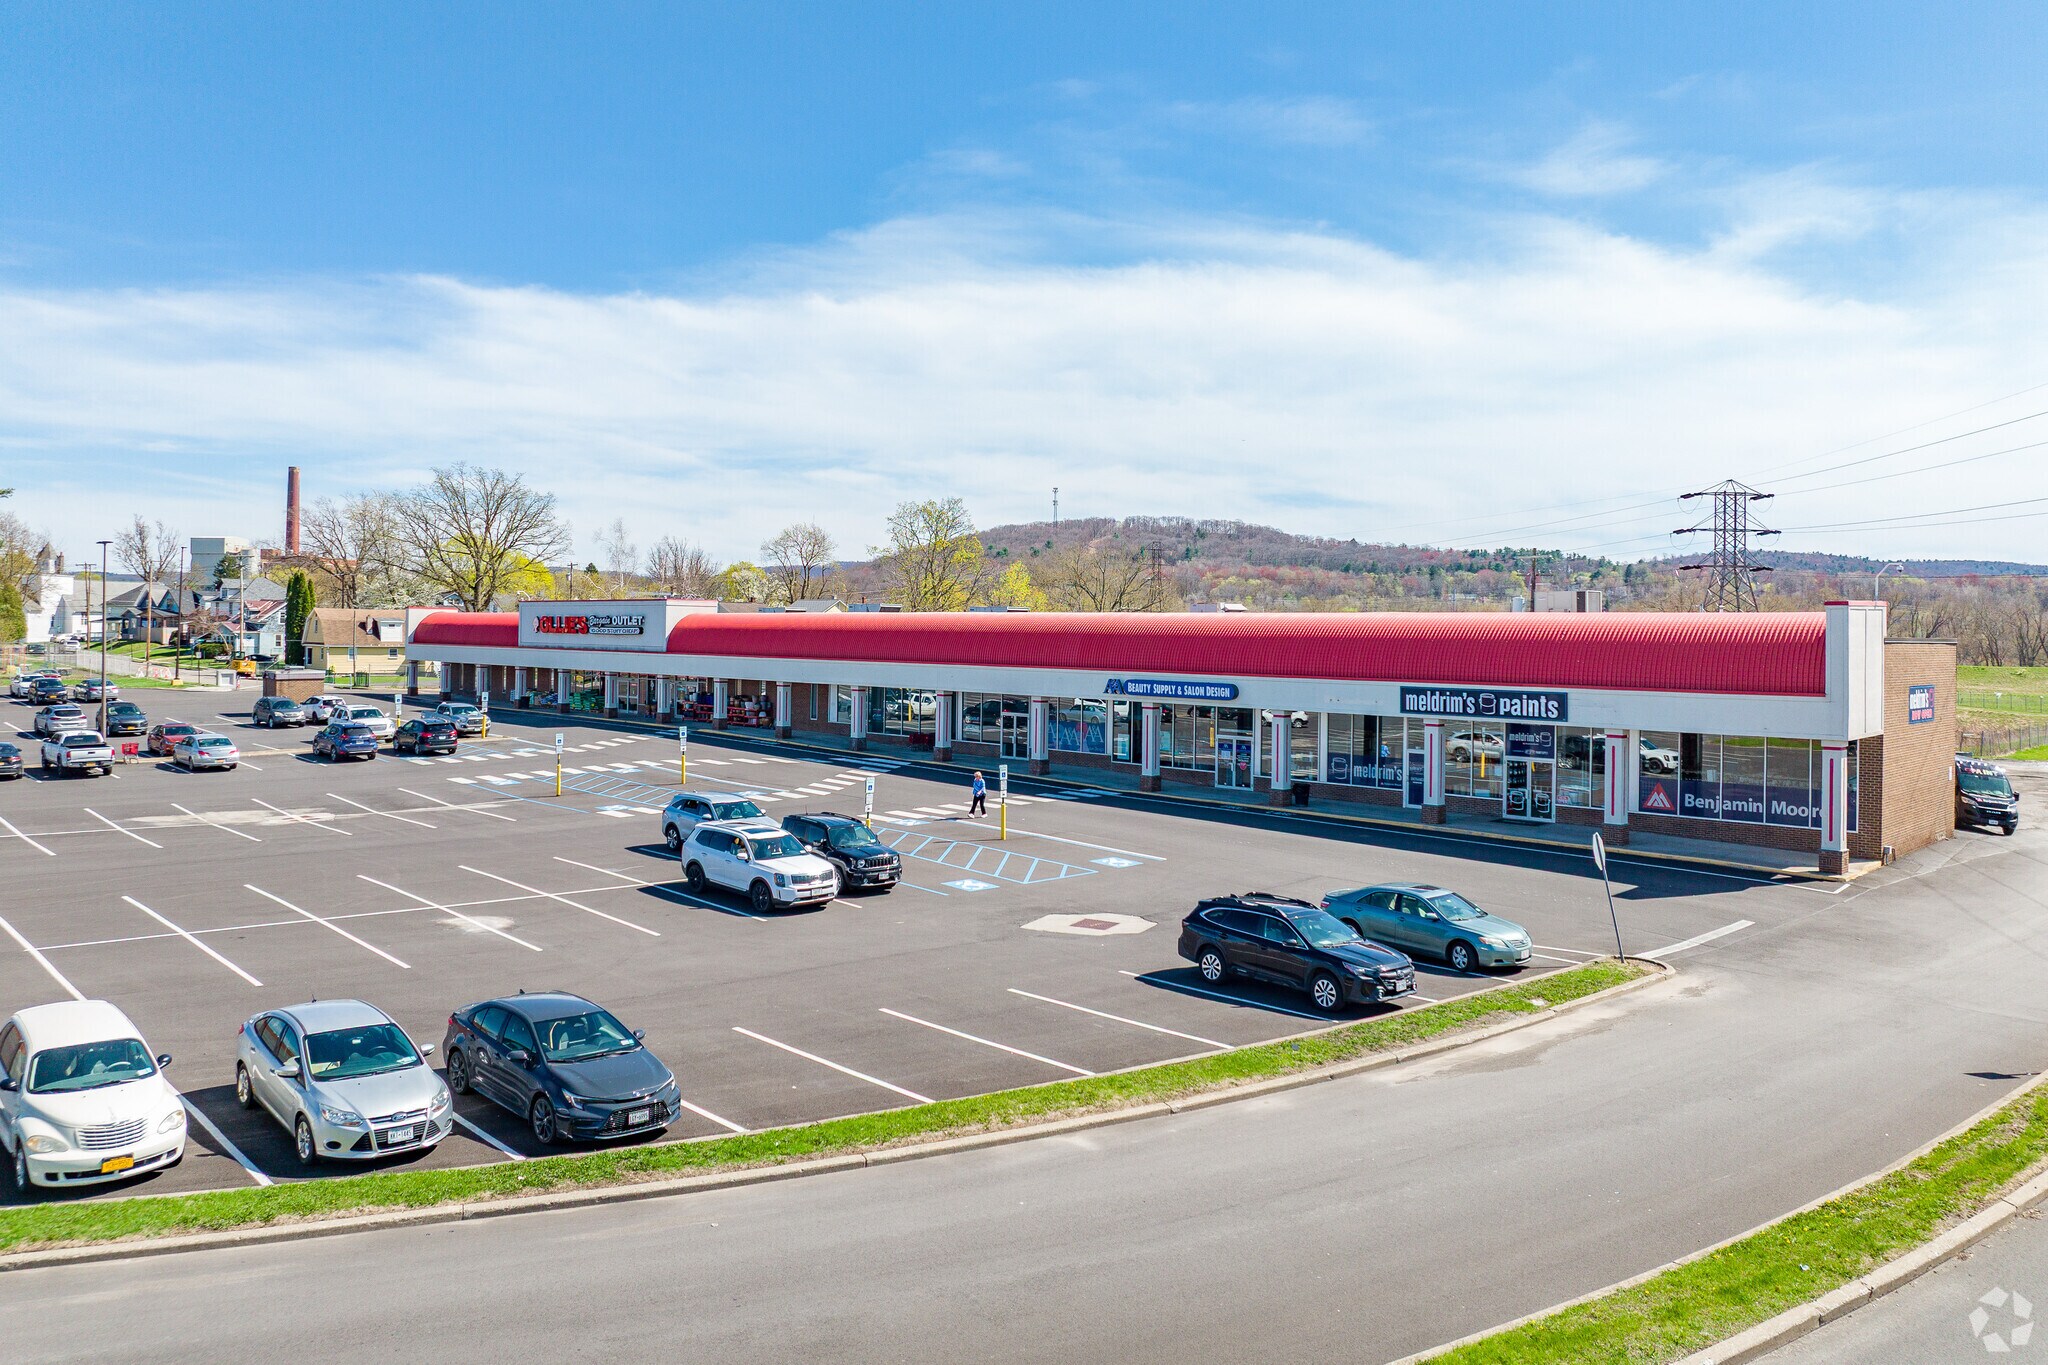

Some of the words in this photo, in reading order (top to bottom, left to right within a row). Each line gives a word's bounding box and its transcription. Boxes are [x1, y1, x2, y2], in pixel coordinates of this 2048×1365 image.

[540, 615, 588, 634] OLLIE'S
[612, 615, 642, 626] OUTLET
[1127, 682, 1151, 693] BEAUTY
[1153, 683, 1176, 695] SUPPLY
[1177, 685, 1182, 695] &
[1184, 684, 1205, 696] SALON
[1206, 686, 1230, 697] DESIGN
[1405, 690, 1476, 714] meldrim's
[1499, 694, 1559, 719] paints
[1509, 732, 1540, 743] meldrim's
[1353, 763, 1403, 781] meldrim's
[1684, 793, 1763, 814] Benjamin
